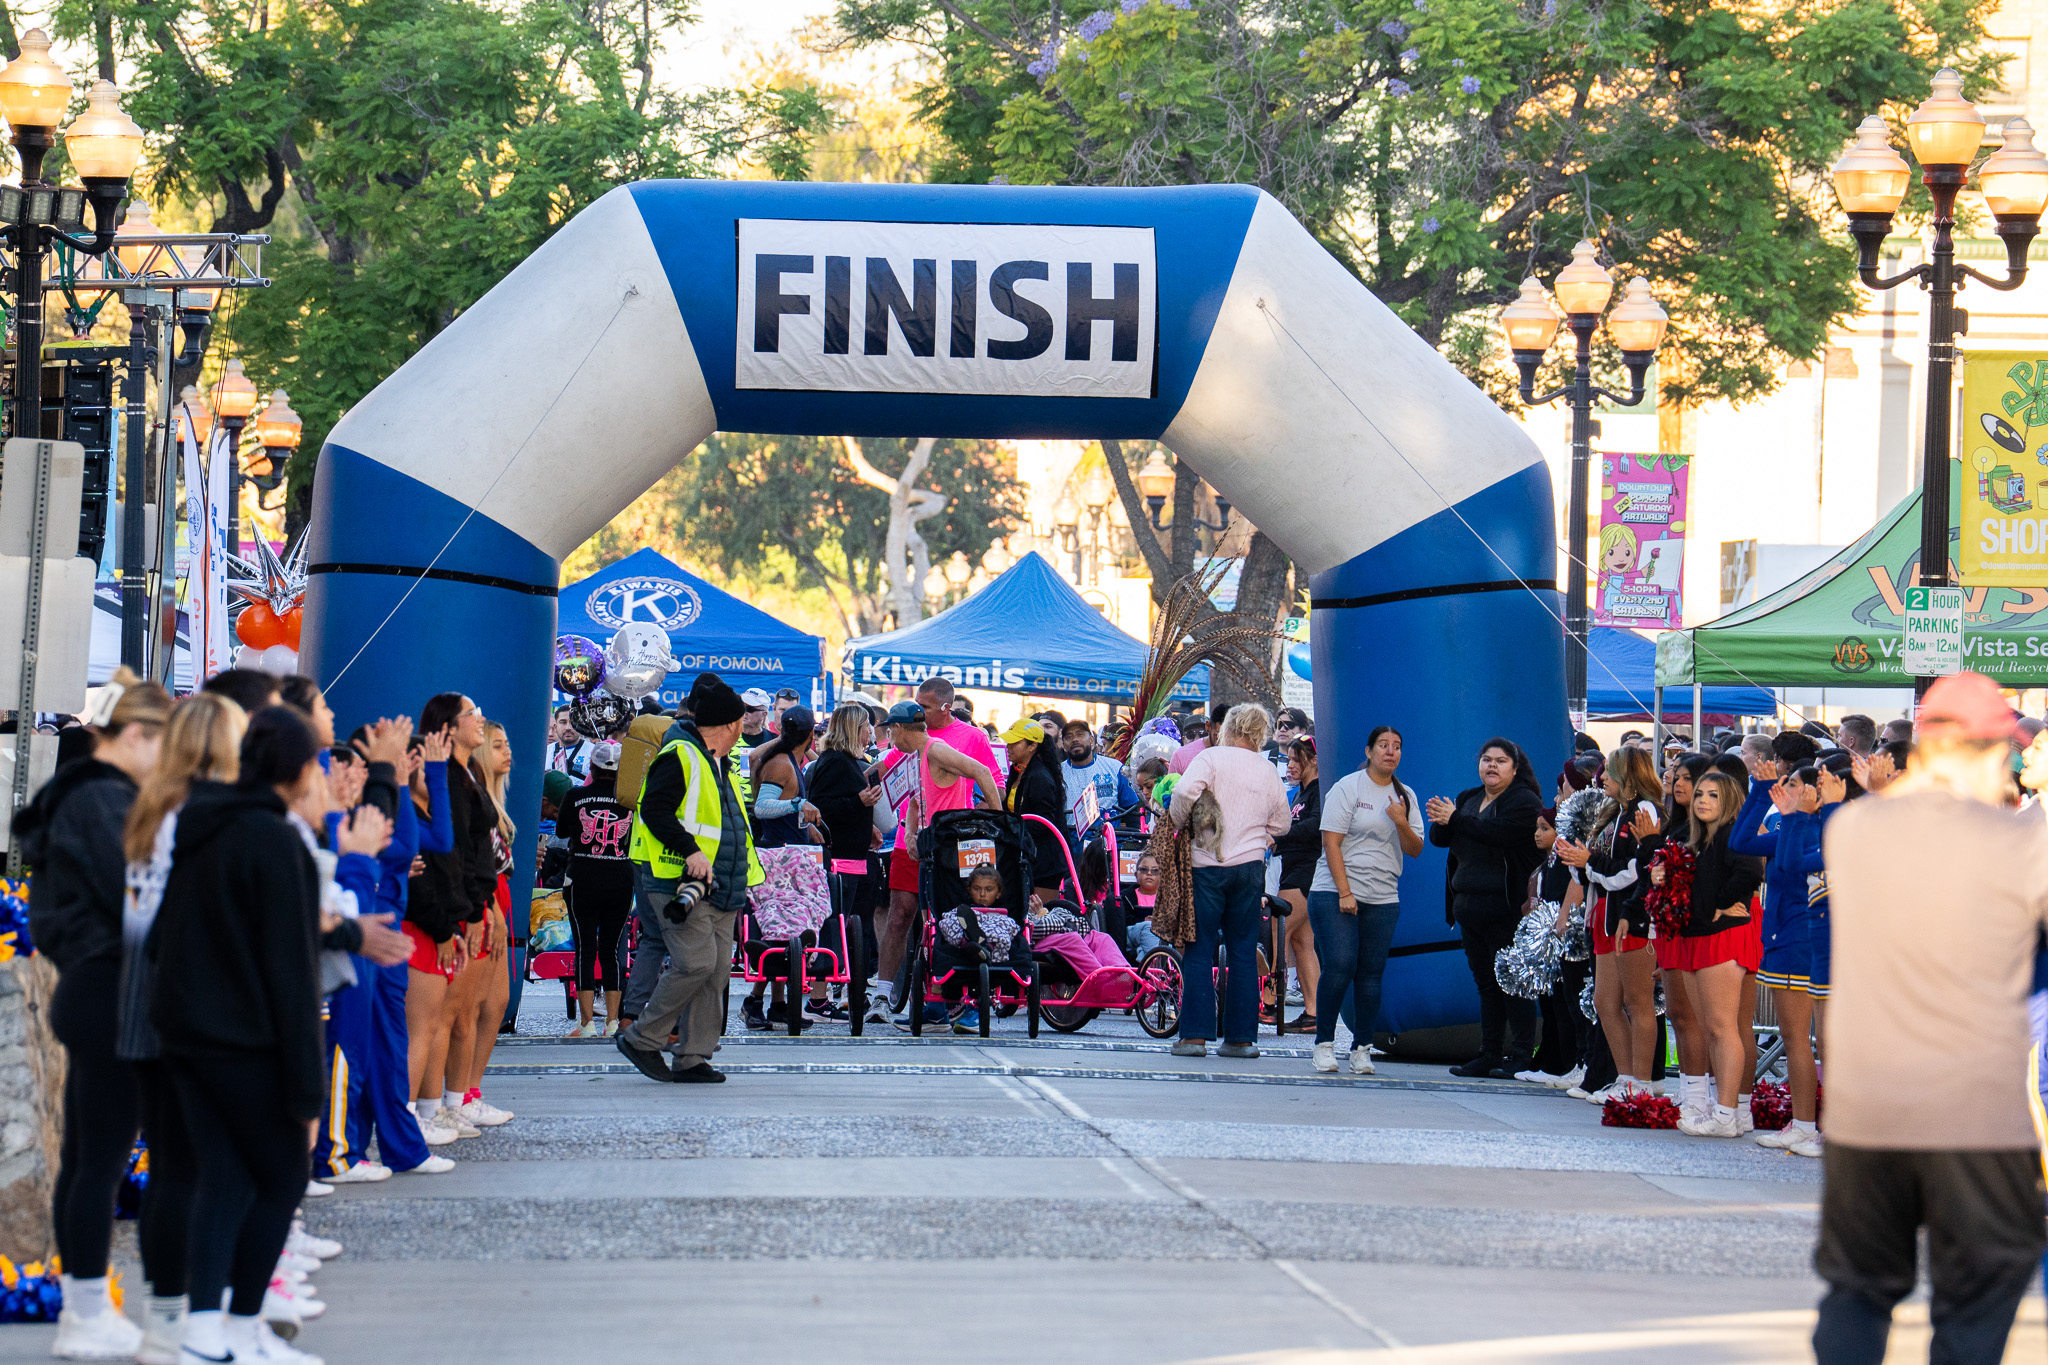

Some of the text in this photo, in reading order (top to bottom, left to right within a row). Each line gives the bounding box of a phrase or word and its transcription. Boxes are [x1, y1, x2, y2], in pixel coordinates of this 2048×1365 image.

[753, 253, 1140, 362] FINISH
[1618, 483, 1671, 492] DOWNTOWN
[1617, 499, 1630, 511] 2ND
[1630, 493, 1668, 503] POMONA
[1628, 503, 1672, 512] SATURDAY
[1623, 512, 1667, 522] ARTWALK
[607, 581, 683, 597] KIWANIS
[1623, 585, 1657, 594] 5-10PM
[1613, 595, 1664, 605] EVERY 2ND
[1911, 590, 1960, 609] 2 HOUR
[594, 600, 693, 628] INTERIONAL
[1614, 606, 1663, 616] SATURDAY
[1908, 617, 1959, 634] PARKING
[1908, 639, 1926, 652] 8AM
[1936, 639, 1959, 653] 12AM
[1963, 636, 2018, 657] Vista
[1834, 643, 1868, 664] VVS
[682, 654, 706, 669] OF
[709, 655, 784, 671] POMONA
[1978, 660, 2006, 673] and
[862, 655, 1202, 697] Kiwanis CLUB OF PONA
[662, 690, 690, 704] CLU
[964, 852, 990, 866] 1326
[1125, 864, 1137, 873] 13
